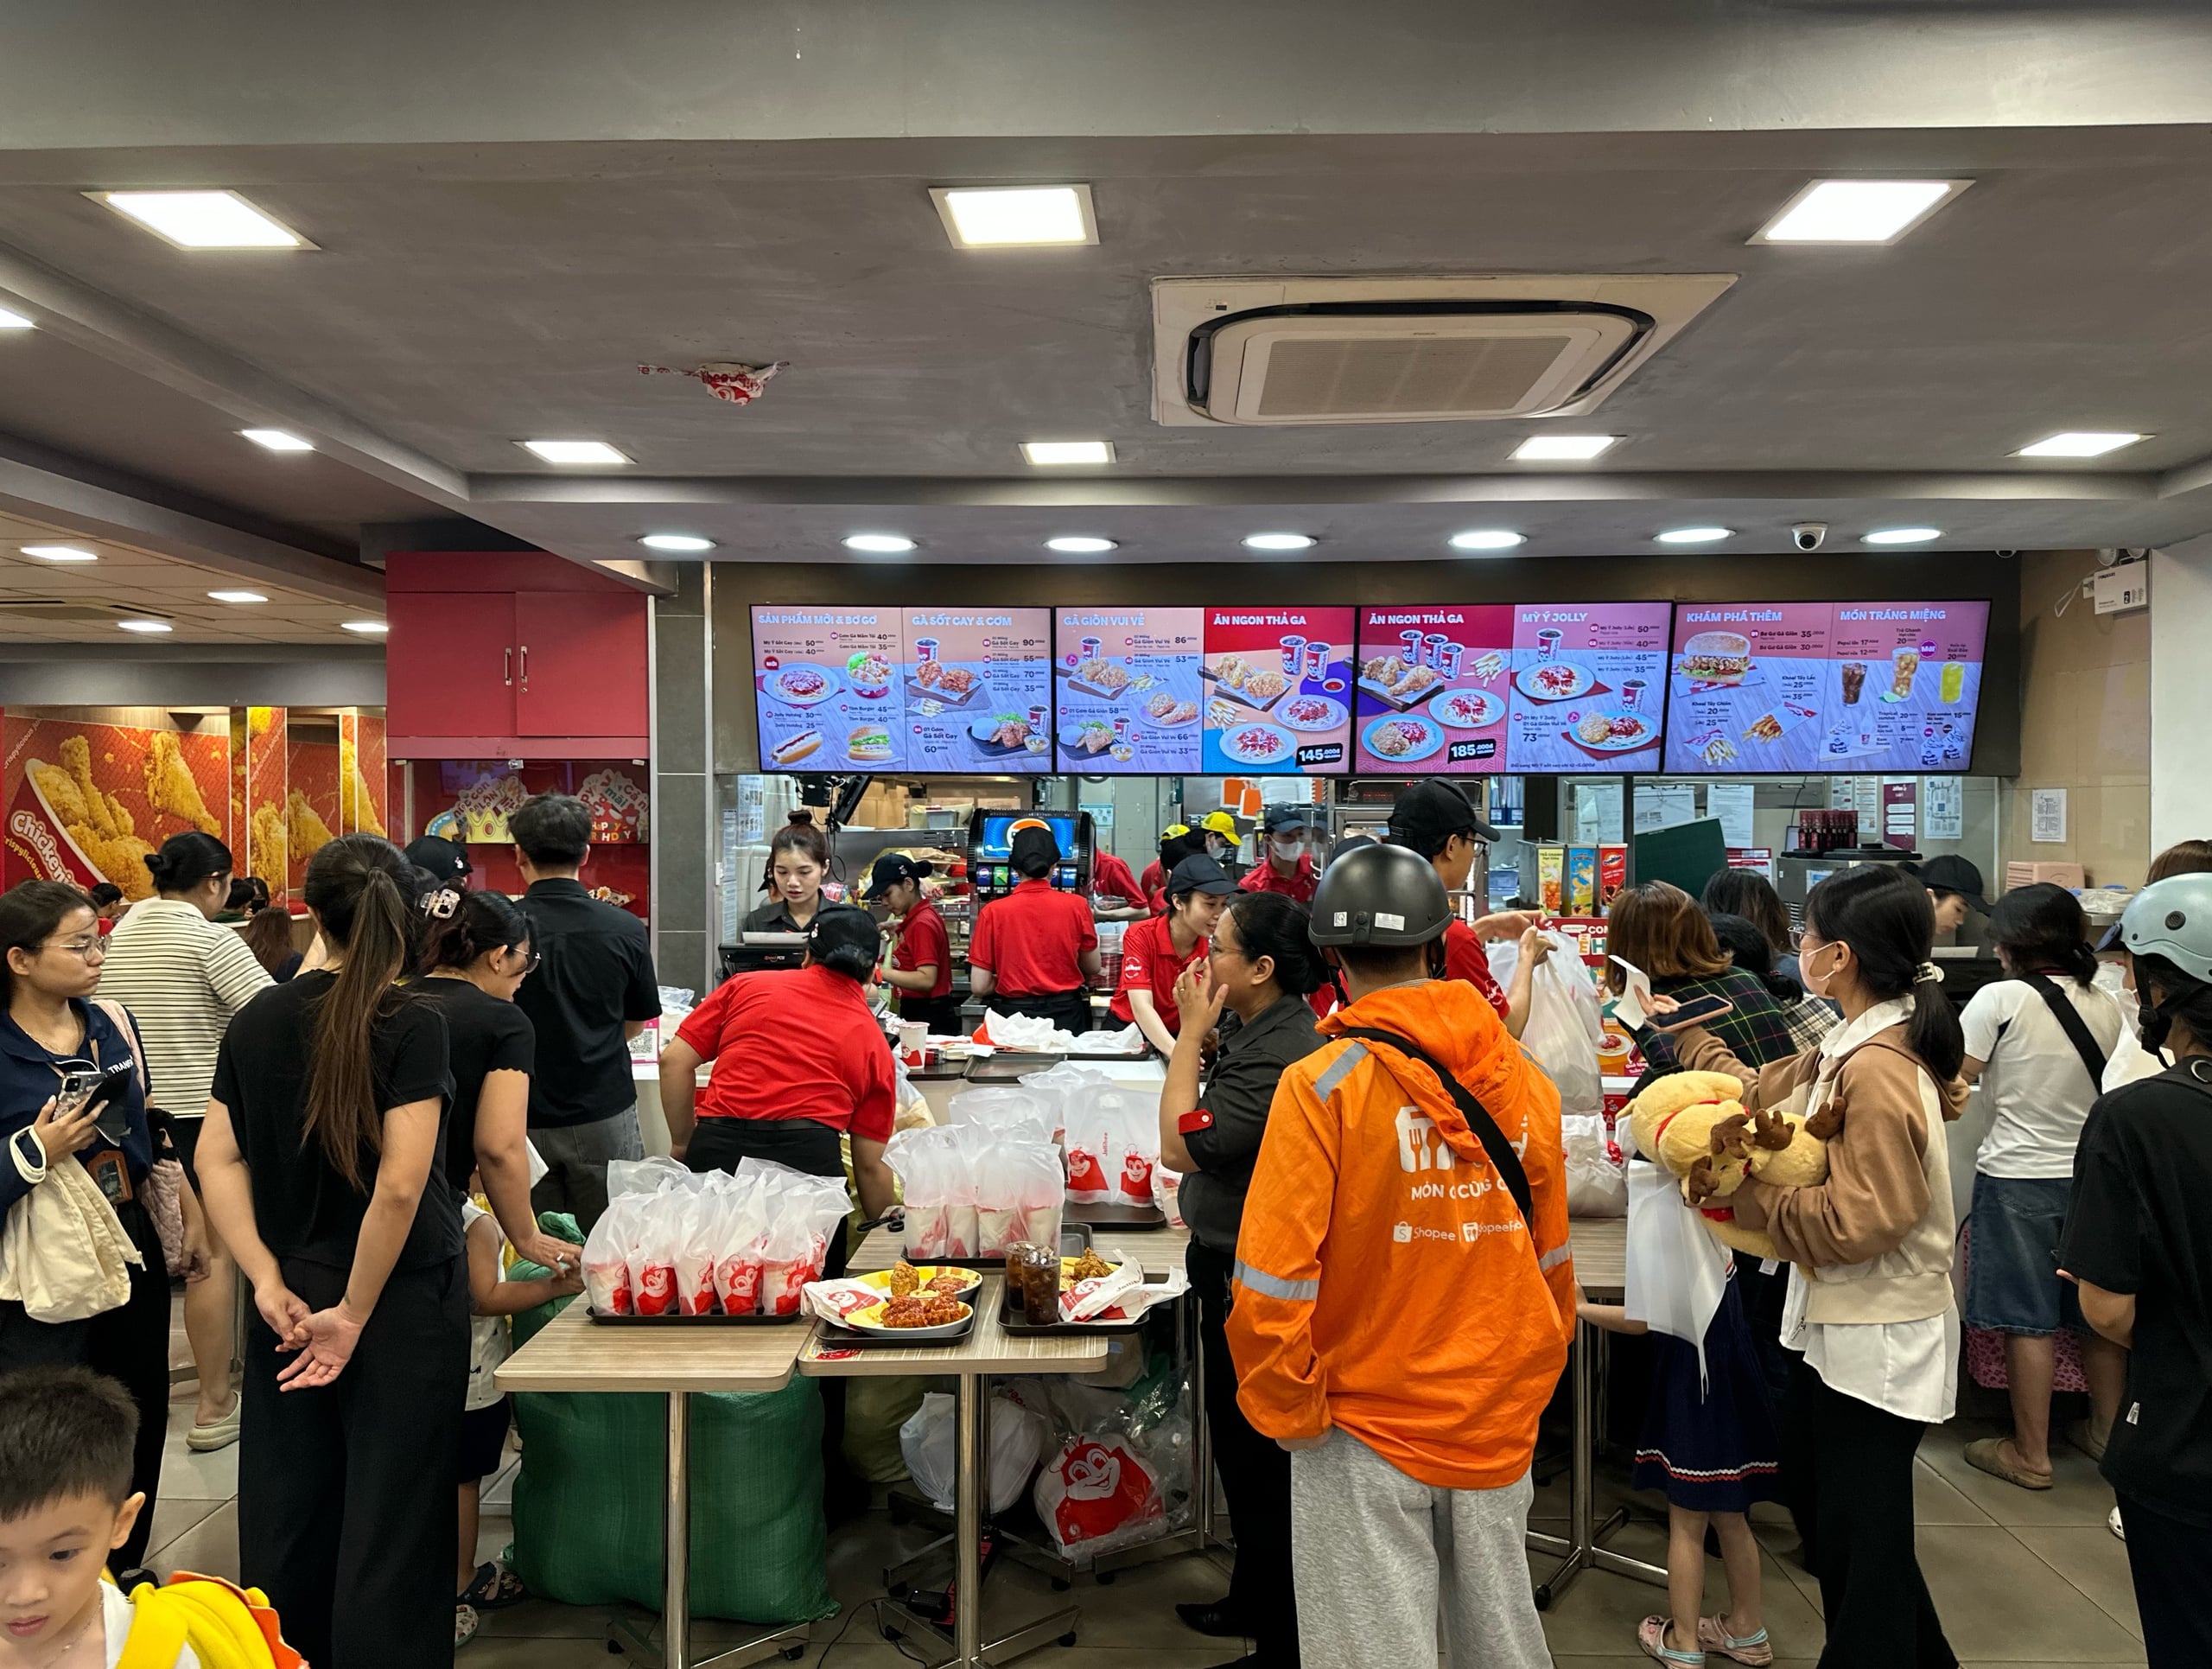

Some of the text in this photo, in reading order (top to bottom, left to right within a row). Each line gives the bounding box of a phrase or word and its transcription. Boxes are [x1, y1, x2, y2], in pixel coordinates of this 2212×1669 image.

[759, 612, 779, 624] SẢN
[782, 611, 811, 624] PHẨM
[912, 615, 928, 625] GÀ
[930, 613, 950, 625] SỐT
[976, 617, 984, 626] &
[986, 615, 1012, 626] CƠM
[1064, 614, 1079, 626] GÀ
[1110, 617, 1128, 626] VUI
[1131, 613, 1145, 626] VẺ
[1213, 611, 1306, 625] ĂN NGON THẢ GA
[1369, 610, 1464, 624] ĂN NGON THẢ GA
[1552, 613, 1588, 622] JOLLY
[1687, 609, 1782, 622] KHÁM PHÁ THÊM
[1840, 608, 1947, 622] MÓN TRÁNG MIỆNG
[1523, 733, 1537, 742] 73
[1299, 749, 1323, 761] 145
[1451, 743, 1476, 757] 185
[1414, 1226, 1456, 1241] Shopee
